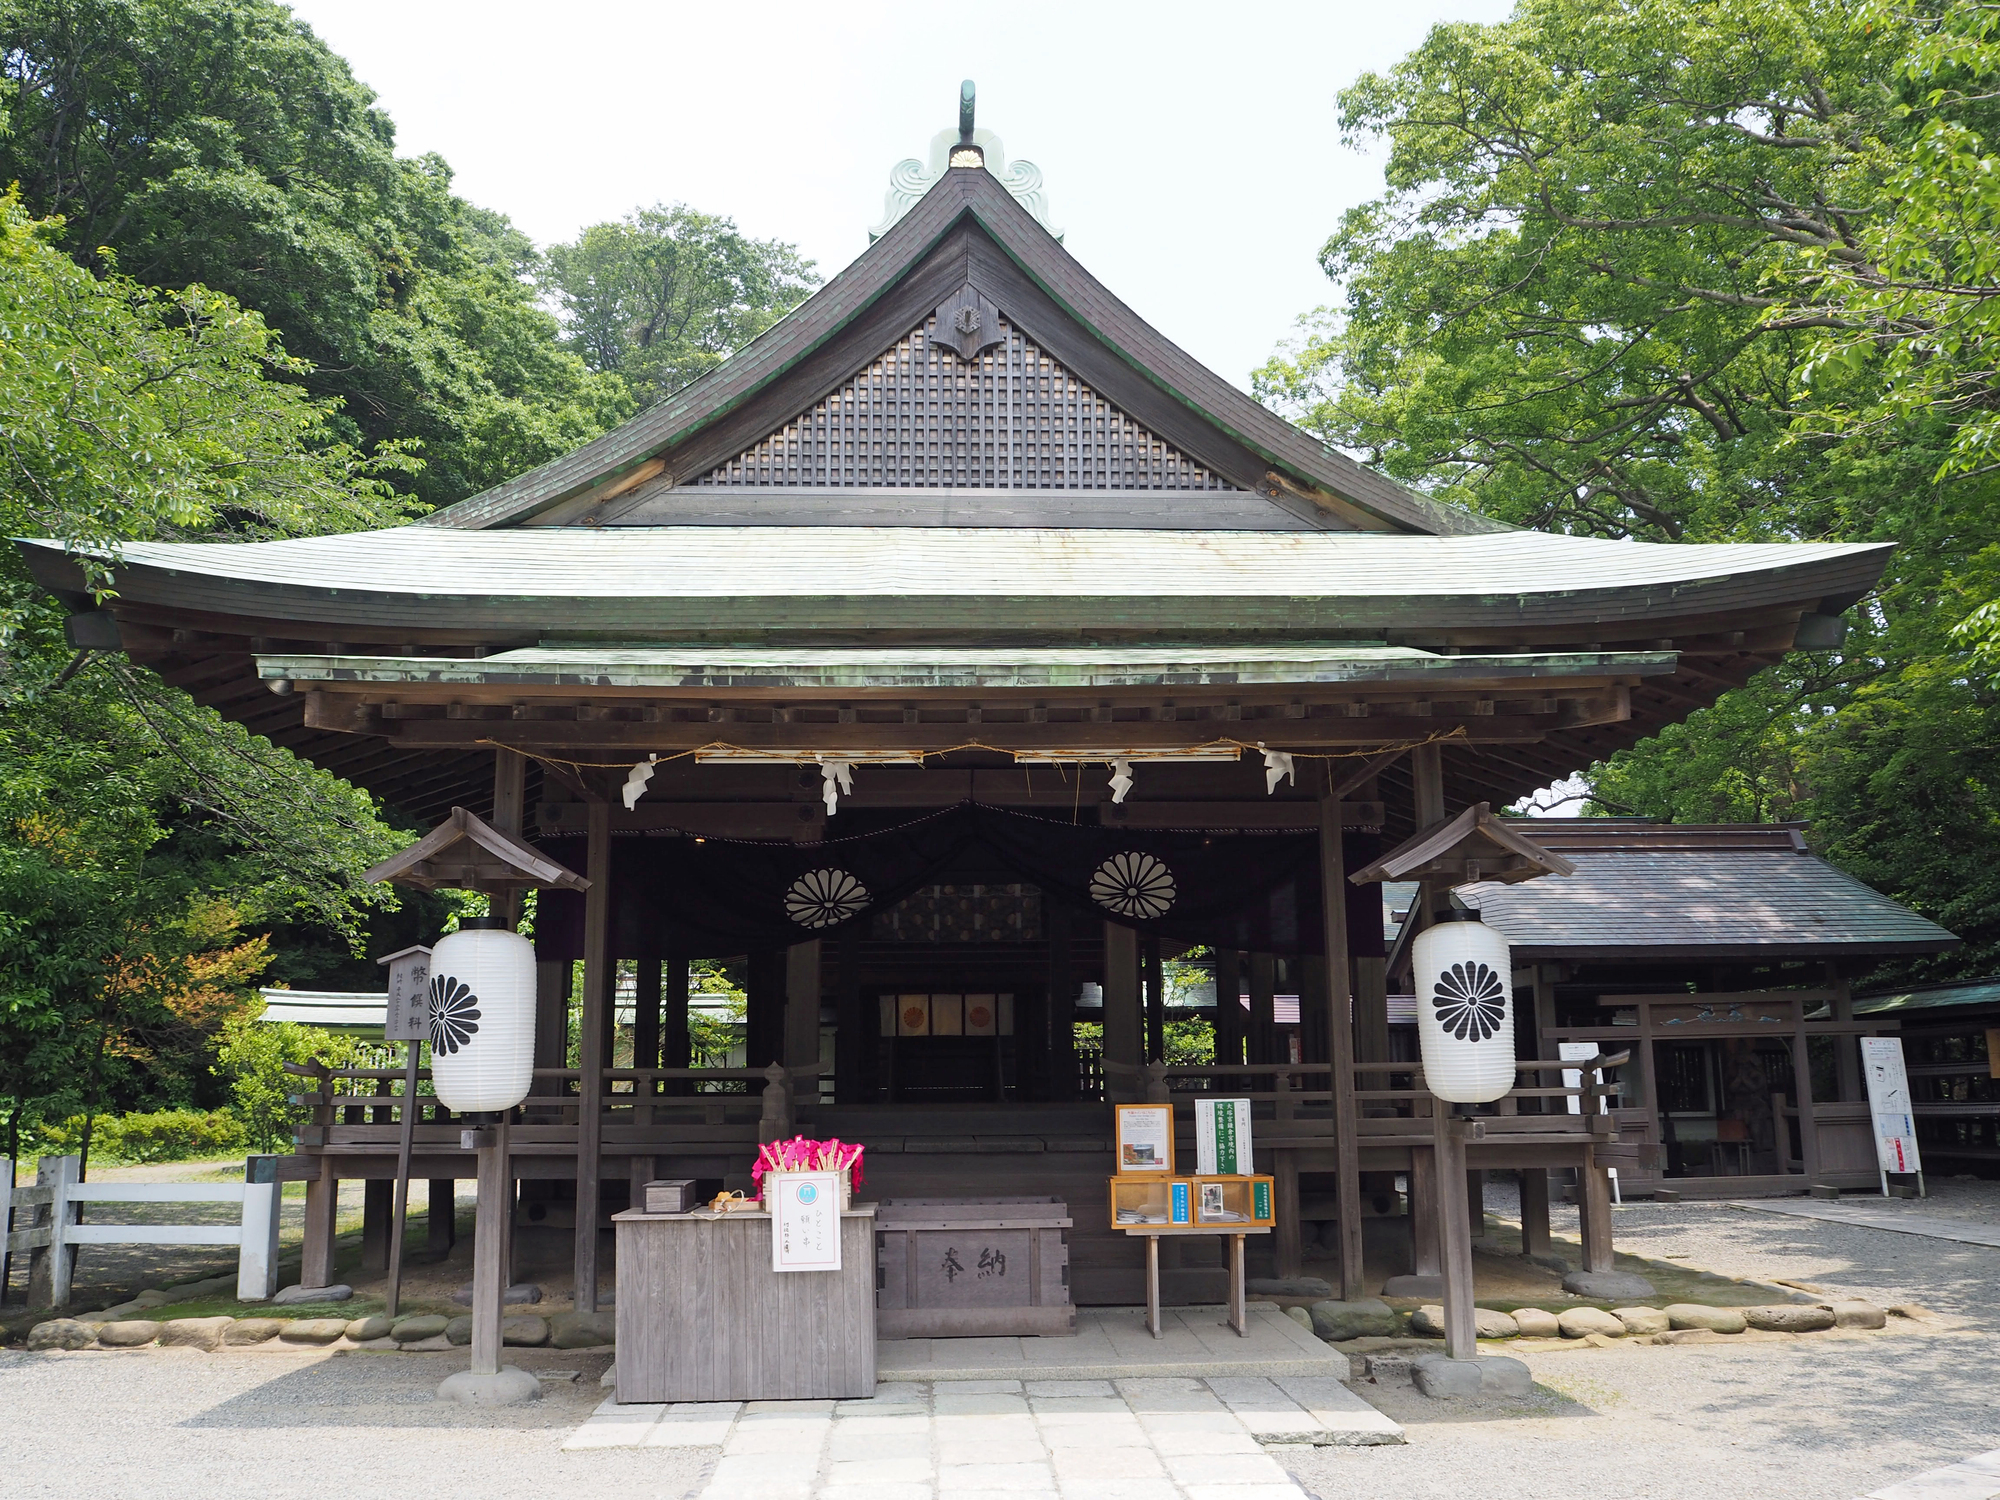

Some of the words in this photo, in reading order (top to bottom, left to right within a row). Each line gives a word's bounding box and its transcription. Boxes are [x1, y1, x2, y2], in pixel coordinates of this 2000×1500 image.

[800, 1214, 811, 1247] 願い串
[815, 1209, 823, 1251] ひとこと
[941, 1247, 1006, 1283] 奉納
